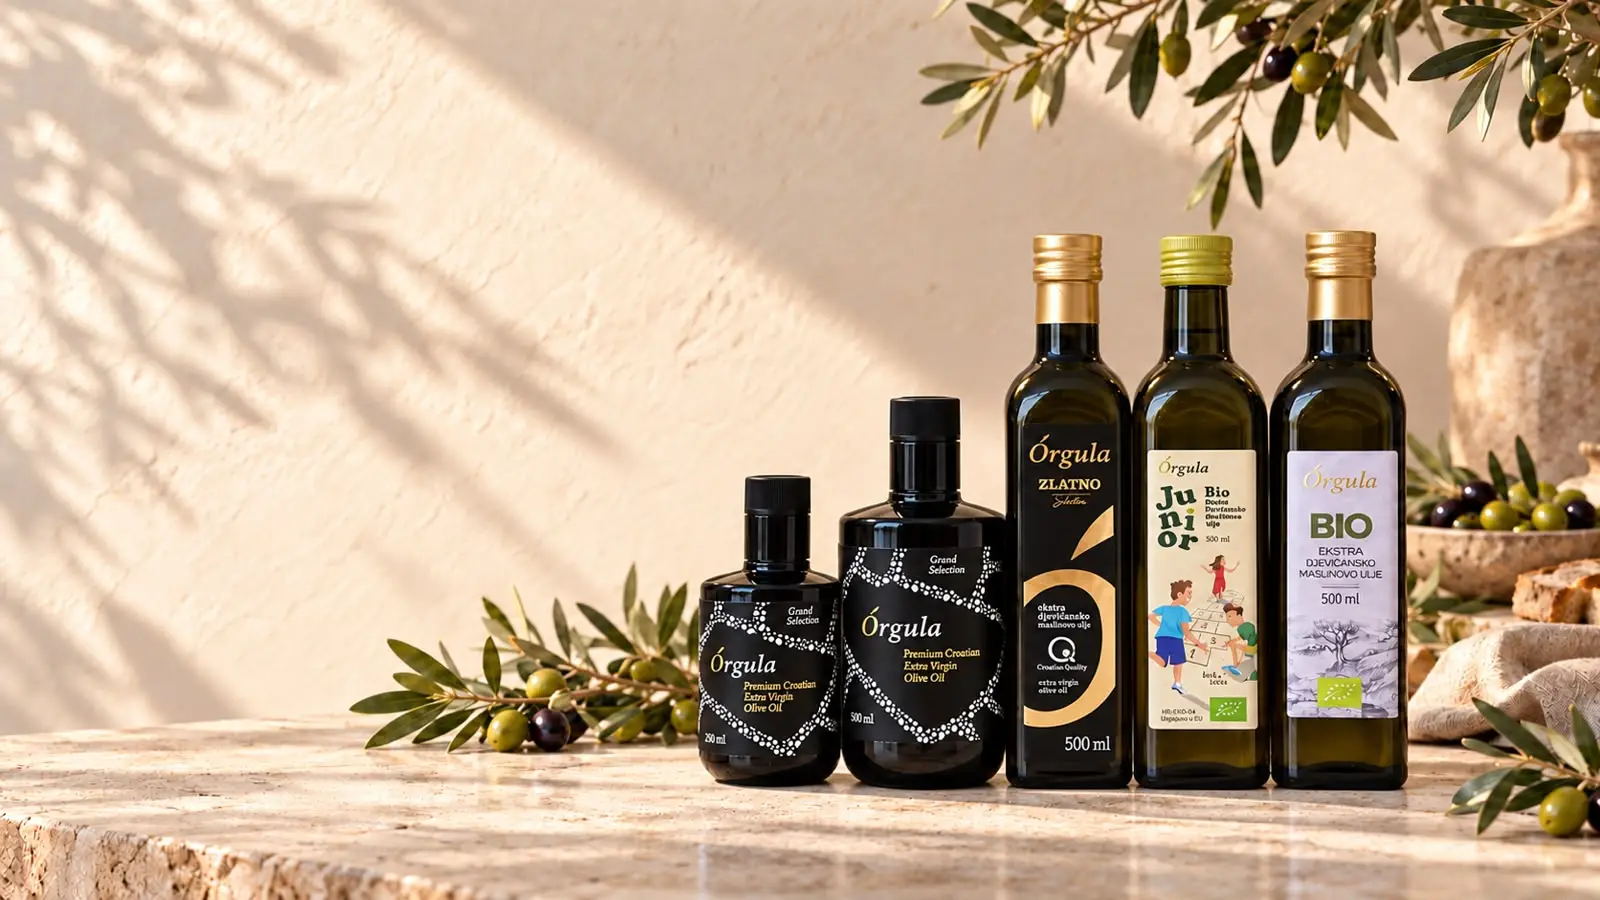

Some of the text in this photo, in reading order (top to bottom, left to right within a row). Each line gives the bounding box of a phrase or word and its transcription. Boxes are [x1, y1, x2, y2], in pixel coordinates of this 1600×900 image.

[1029, 433, 1111, 470] Órgula
[1158, 456, 1209, 477] Órgula
[1038, 478, 1101, 490] ZLATNO
[1303, 463, 1378, 495] Órgula
[1204, 486, 1230, 498] Bio
[1310, 513, 1373, 539] BIO
[1318, 547, 1364, 556] EKSTRA
[930, 554, 957, 564] Grand
[928, 565, 965, 575] Selection
[1299, 569, 1383, 579] MASLINOVO ULJE
[1321, 592, 1360, 605] 500 ml
[788, 606, 813, 616] Grand
[786, 616, 819, 626] Selection
[861, 606, 942, 644] Órgula
[903, 648, 981, 659] Premium Croatian
[710, 647, 776, 679] Órgula
[903, 661, 958, 673] Extra Virgin
[904, 672, 945, 683] Olive Oil
[1057, 678, 1079, 688] virgin
[743, 680, 816, 691] Premium Croatian
[743, 691, 794, 703] Extra Virgin
[743, 702, 783, 713] Olive Oil
[850, 711, 874, 725] 500 ml
[704, 733, 726, 745] 250 ml
[1064, 736, 1111, 751] 500 ml
